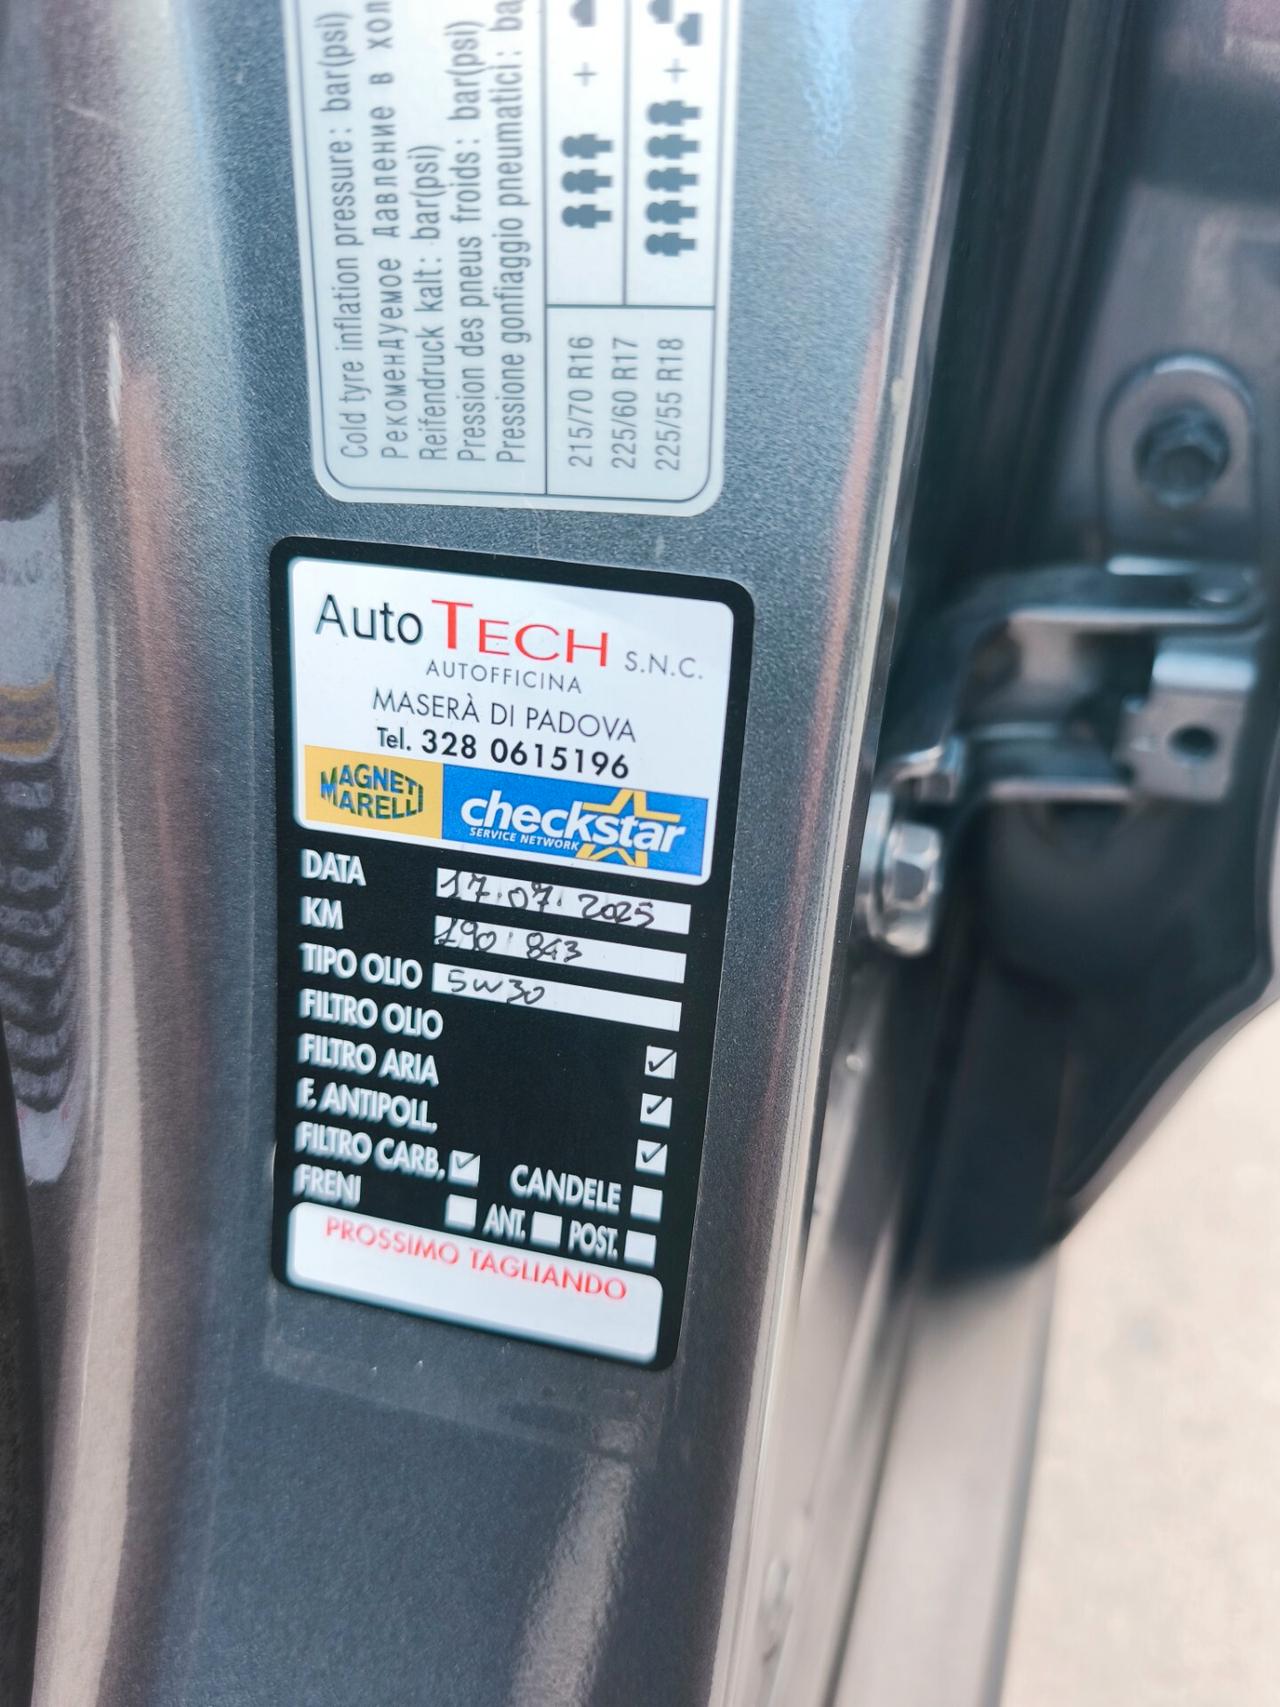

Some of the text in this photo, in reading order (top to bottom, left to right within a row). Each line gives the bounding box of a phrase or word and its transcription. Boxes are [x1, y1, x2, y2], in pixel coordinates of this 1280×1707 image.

[314, 12, 356, 112] bar(psi)
[443, 21, 486, 121] bar(psi)
[407, 145, 447, 242] bar(psi)
[454, 236, 489, 308] pneus
[491, 219, 530, 344] gonfiaggio
[331, 262, 363, 352] inflation
[453, 318, 484, 357] des
[335, 361, 373, 402] tyre
[414, 326, 447, 461] Reifendruck
[495, 354, 526, 463] Pressione
[568, 336, 594, 468] 215/70 R16
[611, 337, 638, 469] 225/60 R17
[655, 337, 684, 472] 225/55 R18
[339, 413, 369, 459] Cold
[456, 367, 486, 462] Pression
[426, 660, 582, 694] AUTOFFICINA
[624, 650, 704, 680] S.N.C.
[372, 688, 637, 743] MASERÀ DI PADOVA
[377, 727, 630, 779] Tel. 328 0615196
[320, 763, 423, 799] MAGNETI
[320, 782, 423, 820] MARELLI
[460, 790, 686, 853] checkstar
[469, 827, 580, 851] SERVICE NETWORK
[301, 849, 366, 887] DATA
[301, 896, 344, 930] KM
[300, 942, 423, 989] TIPO OLIO
[299, 989, 443, 1040] FILTRO OLIO
[299, 1034, 439, 1087] FILTRO ARIA
[295, 1122, 372, 1164] FILTRO
[293, 1165, 619, 1258] FRENI ANT. POST.
[510, 1165, 621, 1214] CANDELE
[325, 1217, 627, 1301] PROSSIMO TAGLIANDO
